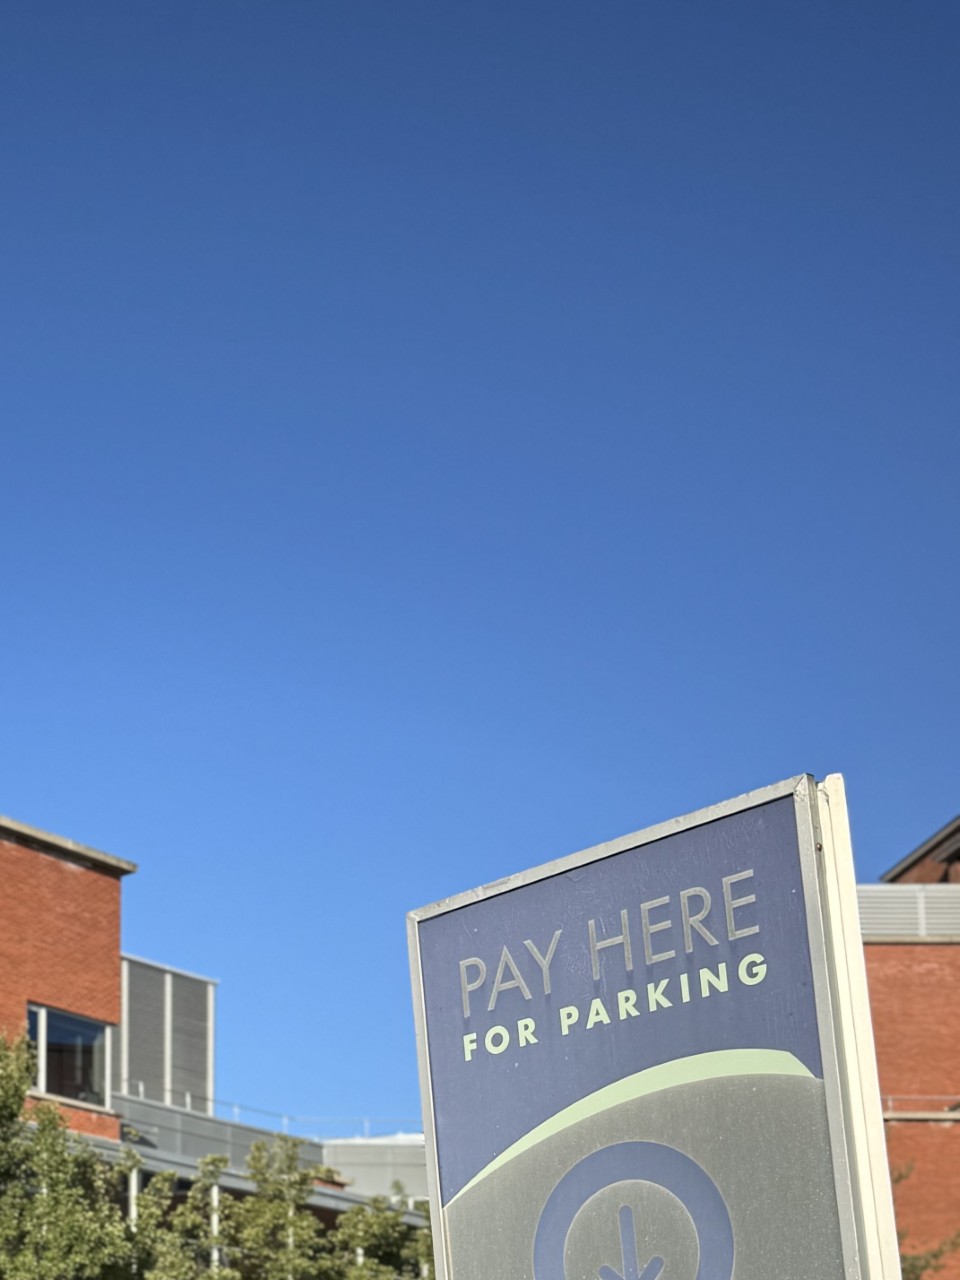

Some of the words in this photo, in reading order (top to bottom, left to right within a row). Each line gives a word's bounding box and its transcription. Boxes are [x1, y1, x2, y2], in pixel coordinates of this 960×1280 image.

[459, 929, 562, 1018] PAY
[587, 868, 759, 981] HERE
[463, 1018, 538, 1061] FOR
[560, 952, 767, 1036] PARKING
